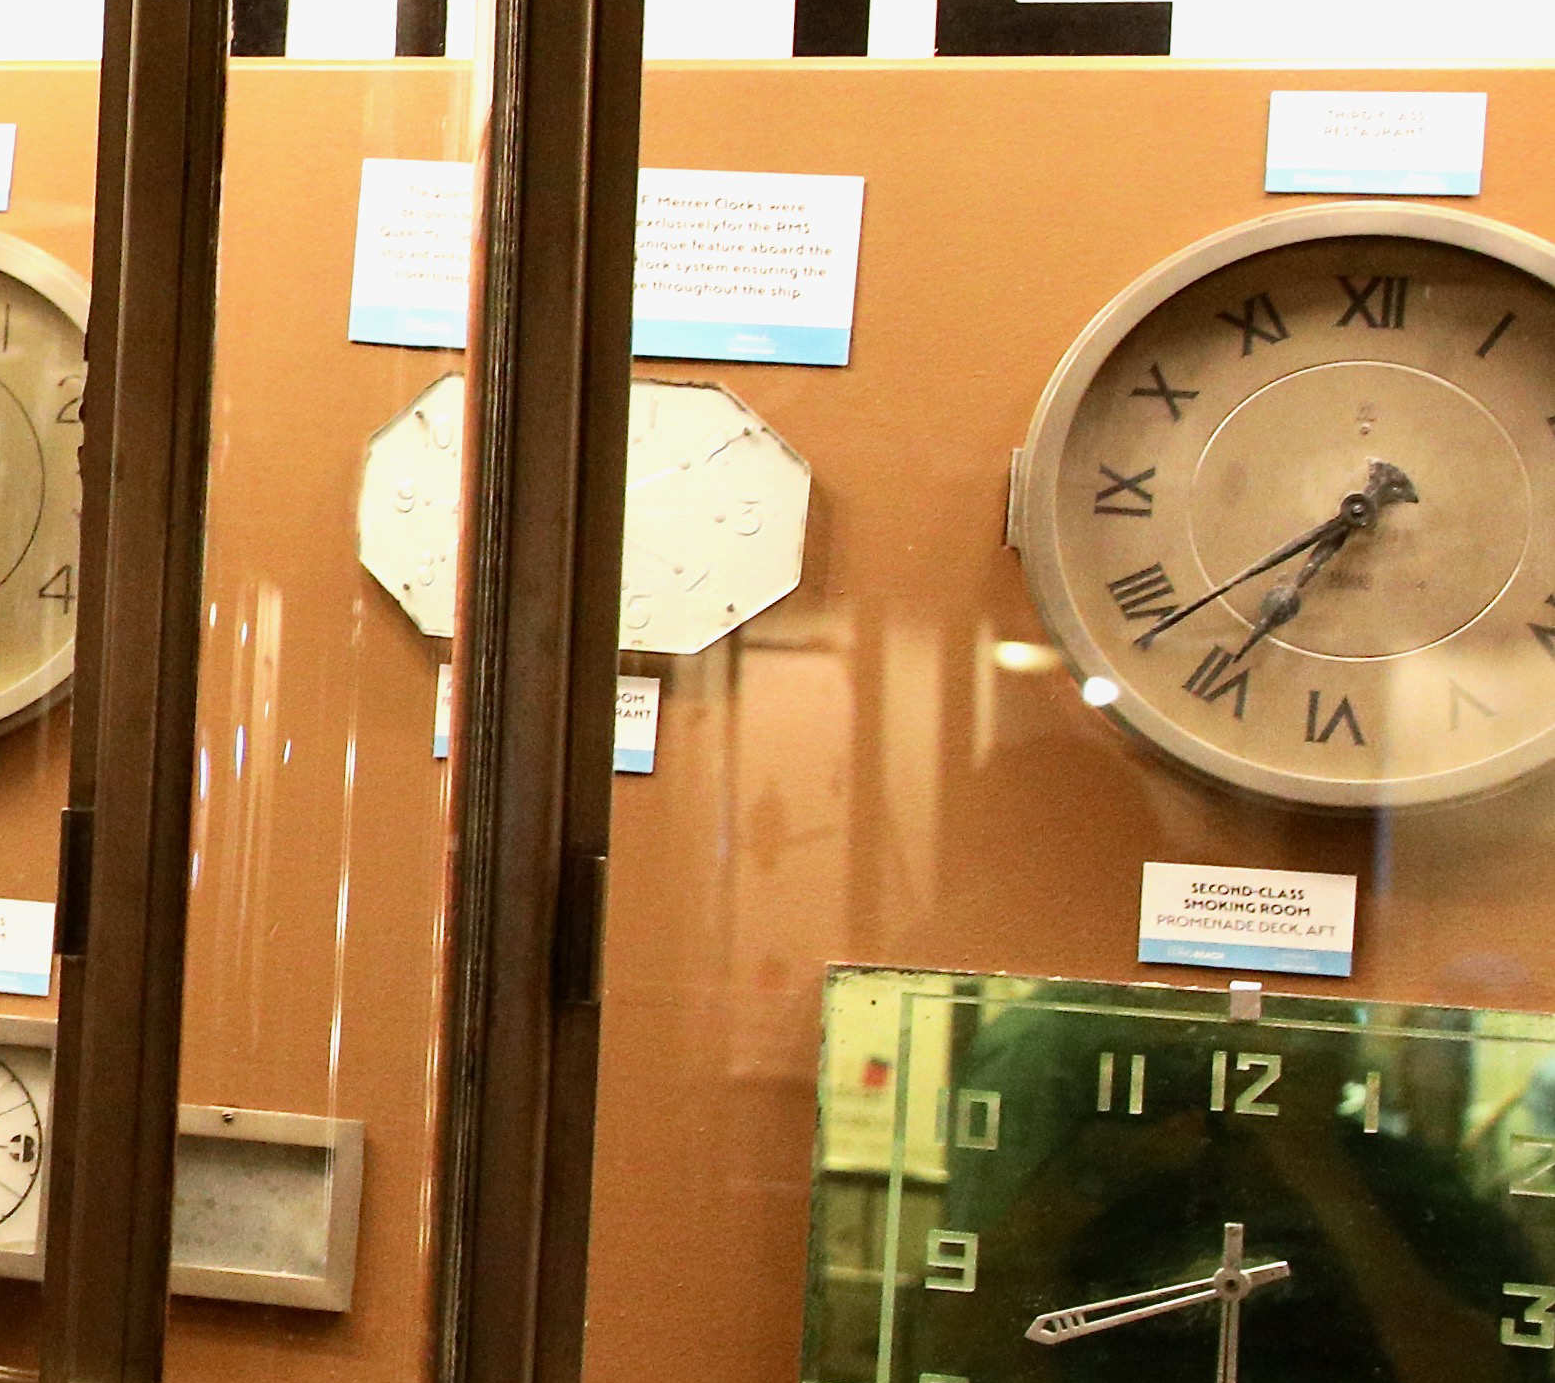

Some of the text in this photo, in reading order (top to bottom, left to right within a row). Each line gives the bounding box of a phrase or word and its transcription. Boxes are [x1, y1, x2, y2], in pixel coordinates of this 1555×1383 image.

[714, 197, 764, 211] Clocks
[748, 221, 772, 232] the
[802, 266, 828, 277] the
[808, 245, 834, 256] the
[742, 284, 767, 295] the
[1337, 275, 1408, 330] XII
[1218, 293, 1290, 356] XI
[1130, 362, 1199, 421] X
[1094, 462, 1156, 518] IX
[39, 564, 75, 614] 4
[1108, 561, 1182, 621] VIII
[1304, 689, 1365, 746] VI
[1183, 897, 1312, 918] SMOKING ROOM
[1191, 881, 1305, 901] SECOND-CLASS
[1156, 914, 1255, 934] PROMENADE
[1305, 924, 1337, 938] AFT
[1097, 1051, 1146, 1115] 11
[1210, 1051, 1283, 1116] 12
[1362, 1070, 1381, 1134] 1
[934, 1088, 1002, 1151] 10
[924, 1230, 979, 1293] 9
